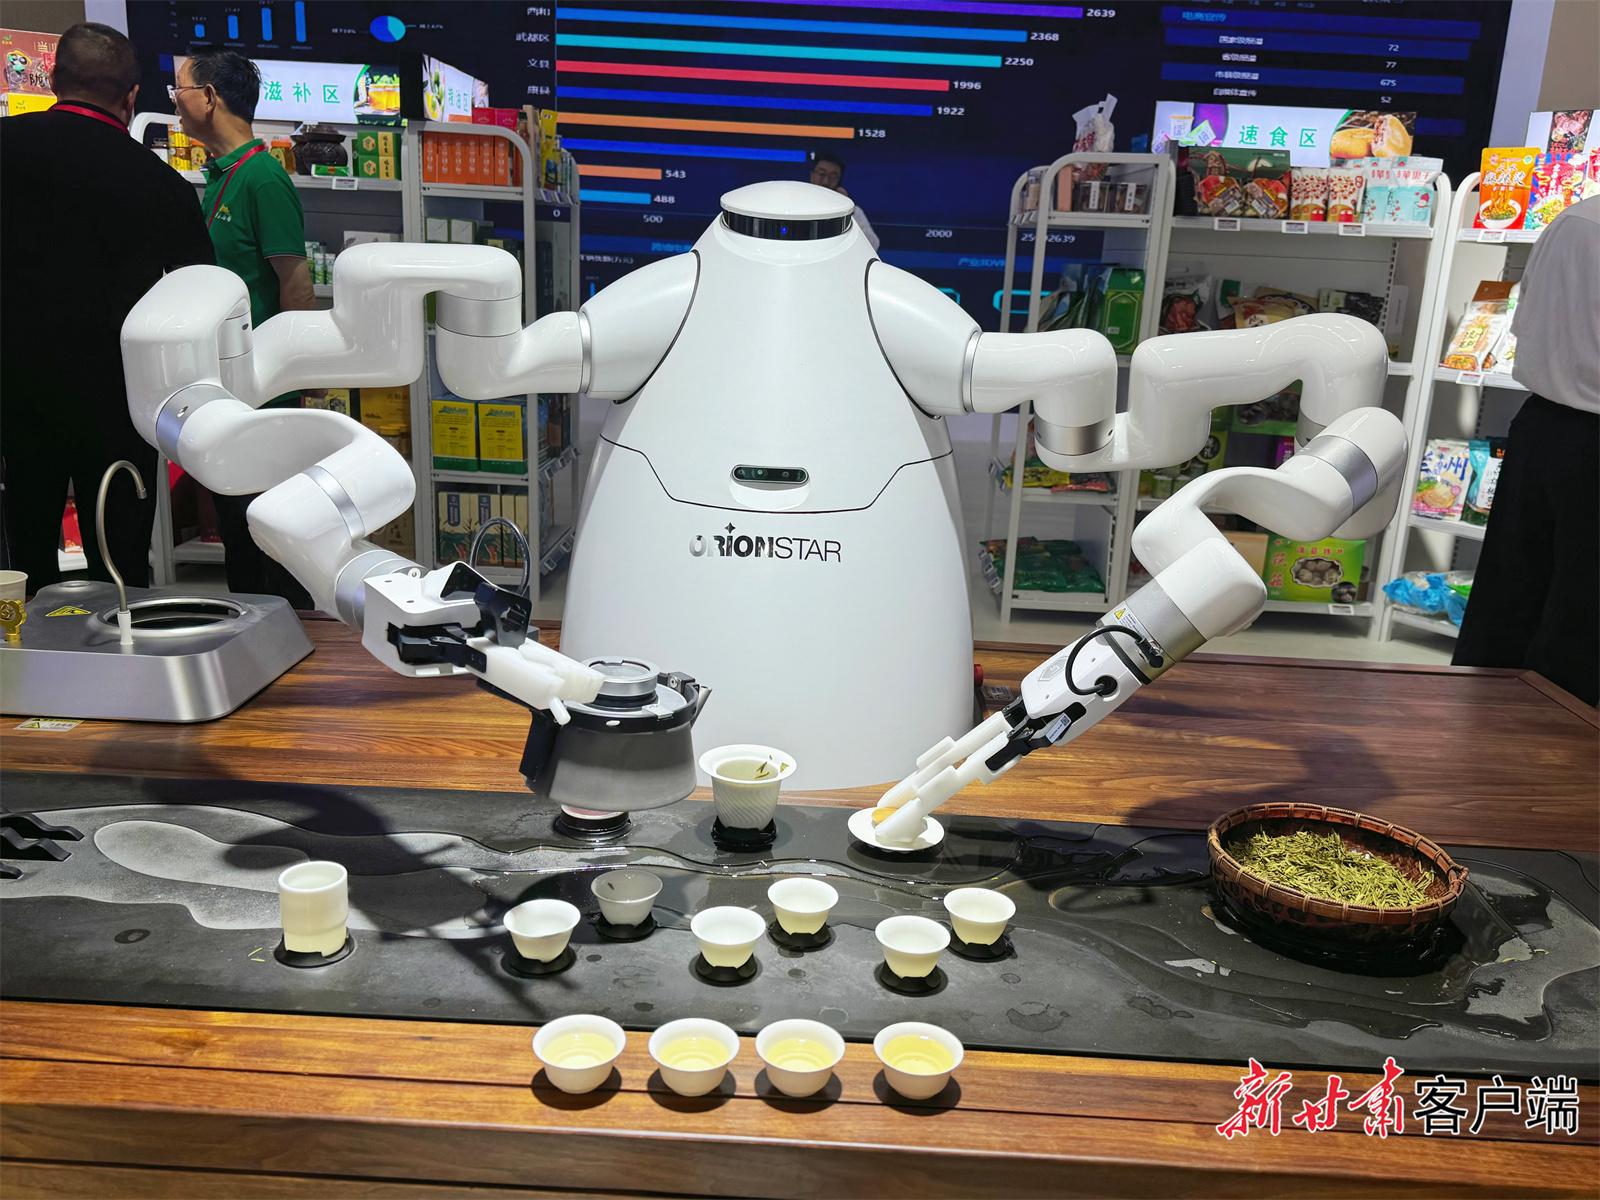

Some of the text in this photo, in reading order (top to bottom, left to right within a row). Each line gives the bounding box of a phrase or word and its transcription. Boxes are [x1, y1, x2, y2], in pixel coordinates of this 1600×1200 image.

[1086, 8, 1116, 18] 2639
[1030, 31, 1060, 42] 2368
[1388, 44, 1400, 52] 72
[1004, 56, 1034, 67] 2250
[1385, 61, 1397, 69] 77
[953, 80, 982, 91] 1996
[1380, 78, 1397, 87] 675
[263, 80, 341, 104] 滋补区
[937, 106, 965, 117] 1922
[858, 128, 886, 138] 1528
[1238, 124, 1318, 148] 速食区
[665, 169, 687, 179] 543
[653, 194, 676, 204] 488
[643, 214, 664, 224] 500
[925, 229, 953, 239] 2000
[1047, 235, 1076, 243] 2639
[689, 533, 842, 563] ORIONSTAR
